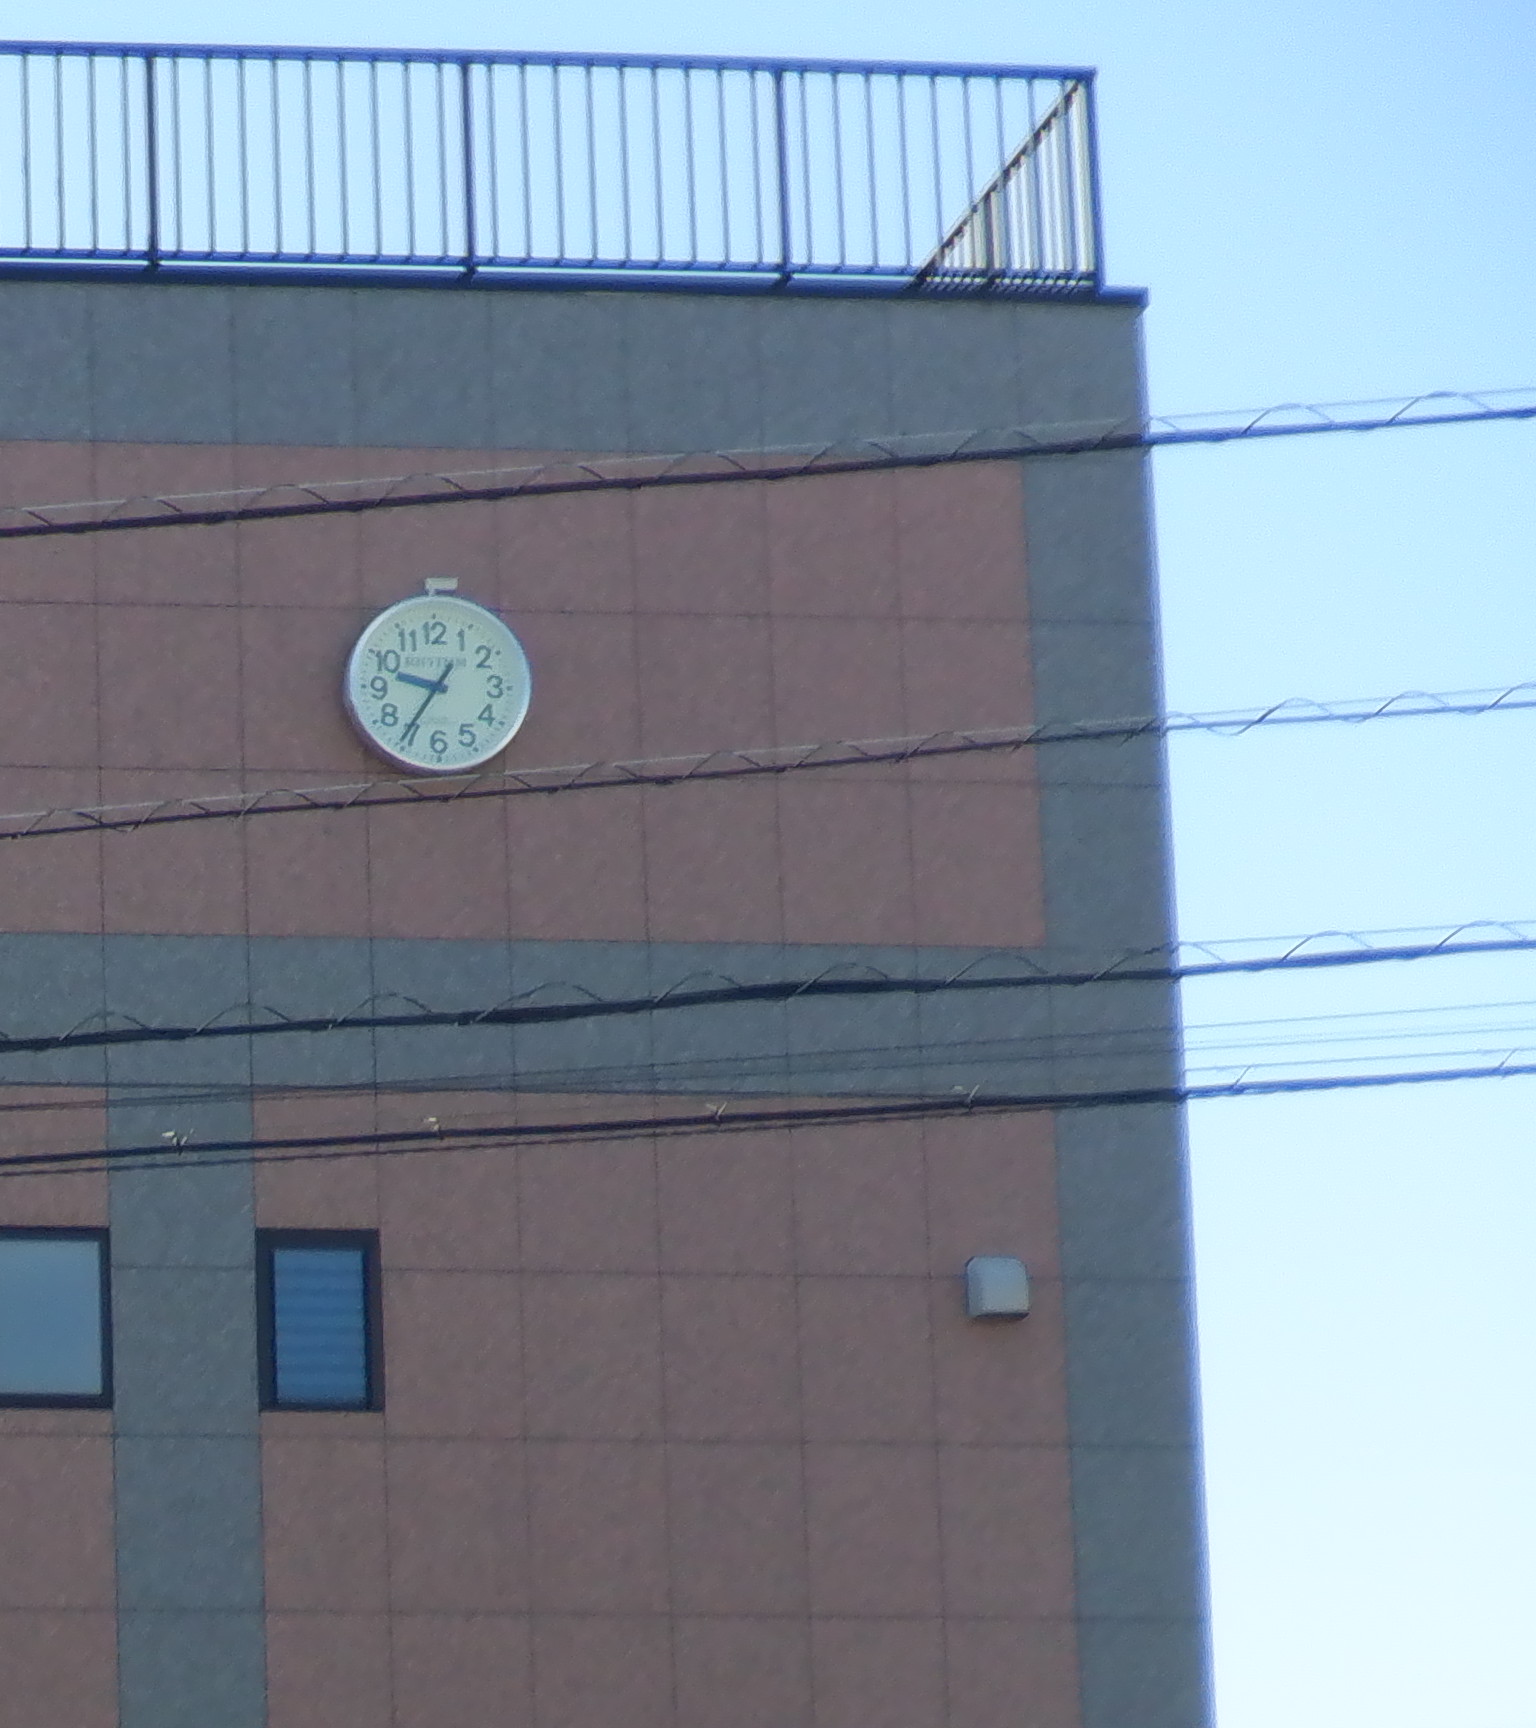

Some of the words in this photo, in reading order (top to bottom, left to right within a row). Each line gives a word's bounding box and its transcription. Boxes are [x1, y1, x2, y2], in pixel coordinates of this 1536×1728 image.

[398, 628, 418, 652] 11
[423, 621, 447, 645] 12
[457, 628, 466, 652] 1
[377, 649, 401, 674] 10
[475, 645, 492, 670] 2
[370, 676, 388, 701] 9
[486, 675, 504, 699] 3
[380, 703, 399, 727] 8
[478, 703, 495, 727] 4
[430, 730, 448, 754] 6
[458, 723, 476, 748] 5
